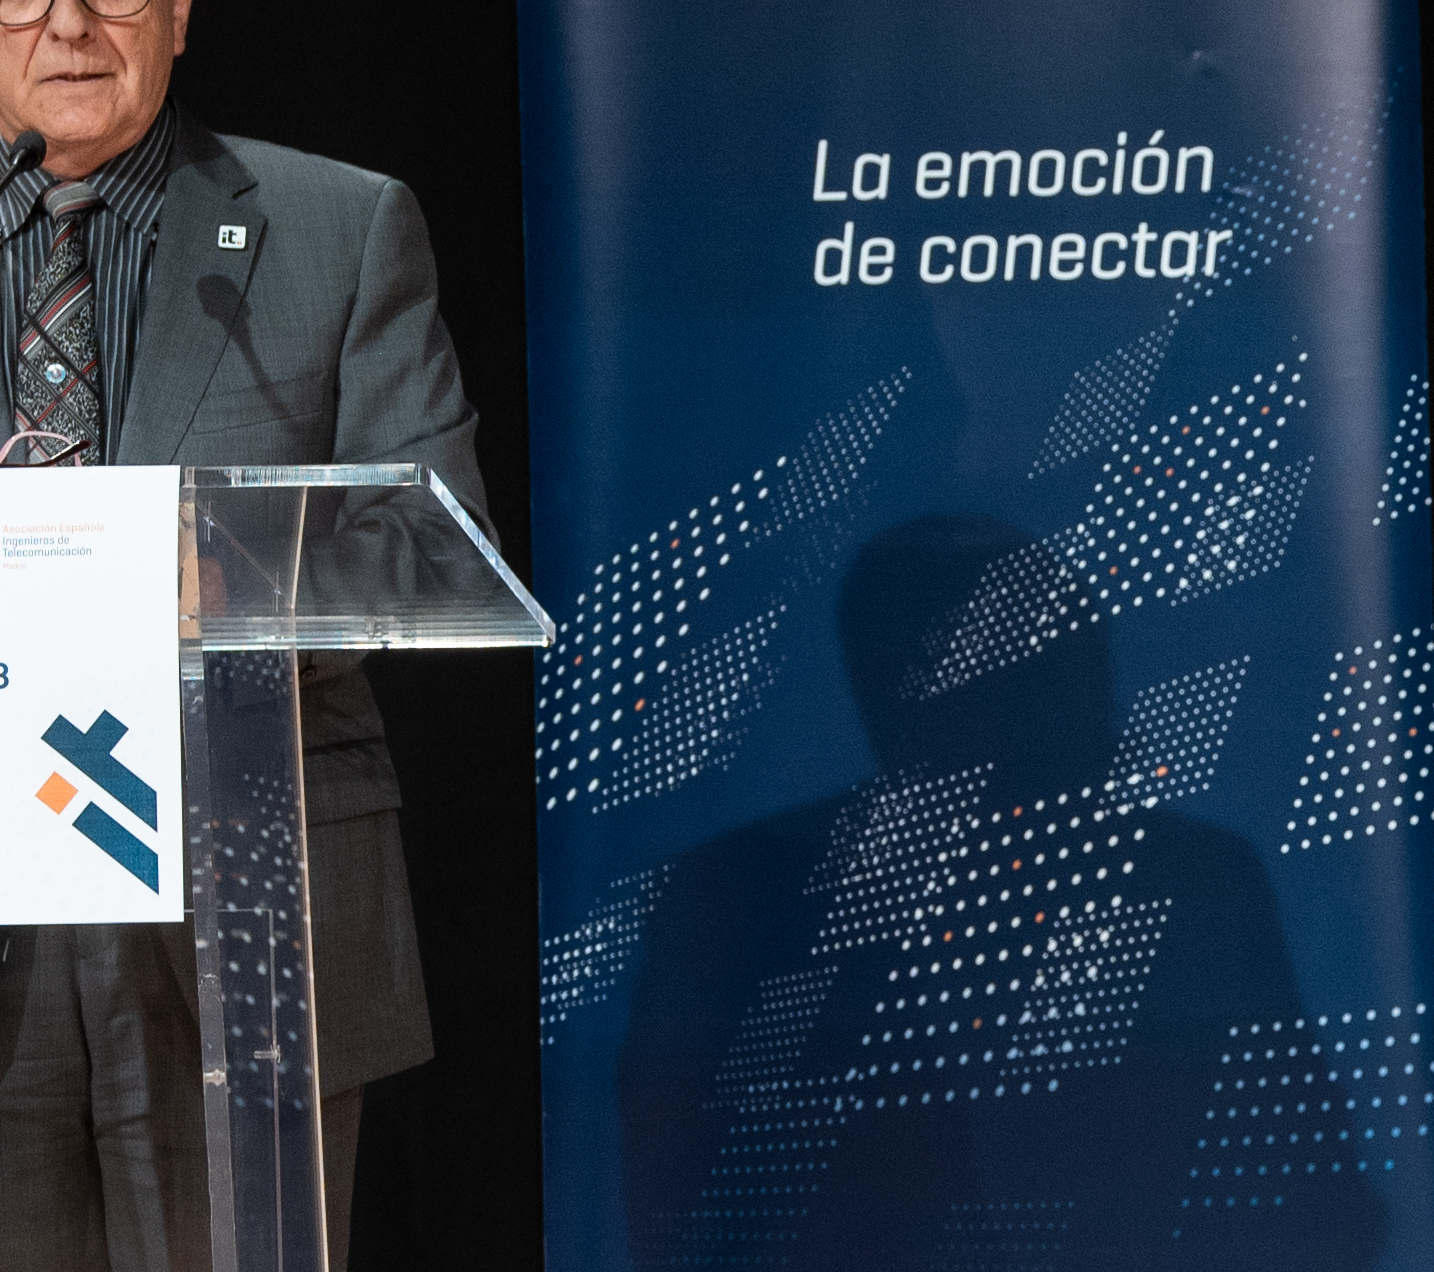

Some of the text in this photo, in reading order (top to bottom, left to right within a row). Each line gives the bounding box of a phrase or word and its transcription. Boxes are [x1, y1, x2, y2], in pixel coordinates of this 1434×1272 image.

[812, 129, 1215, 202] La emoción
[812, 221, 1233, 286] de conectar
[2, 523, 105, 534] Asociación Española
[2, 535, 70, 548] Ingenieros de
[2, 546, 92, 558] Telecomunicación
